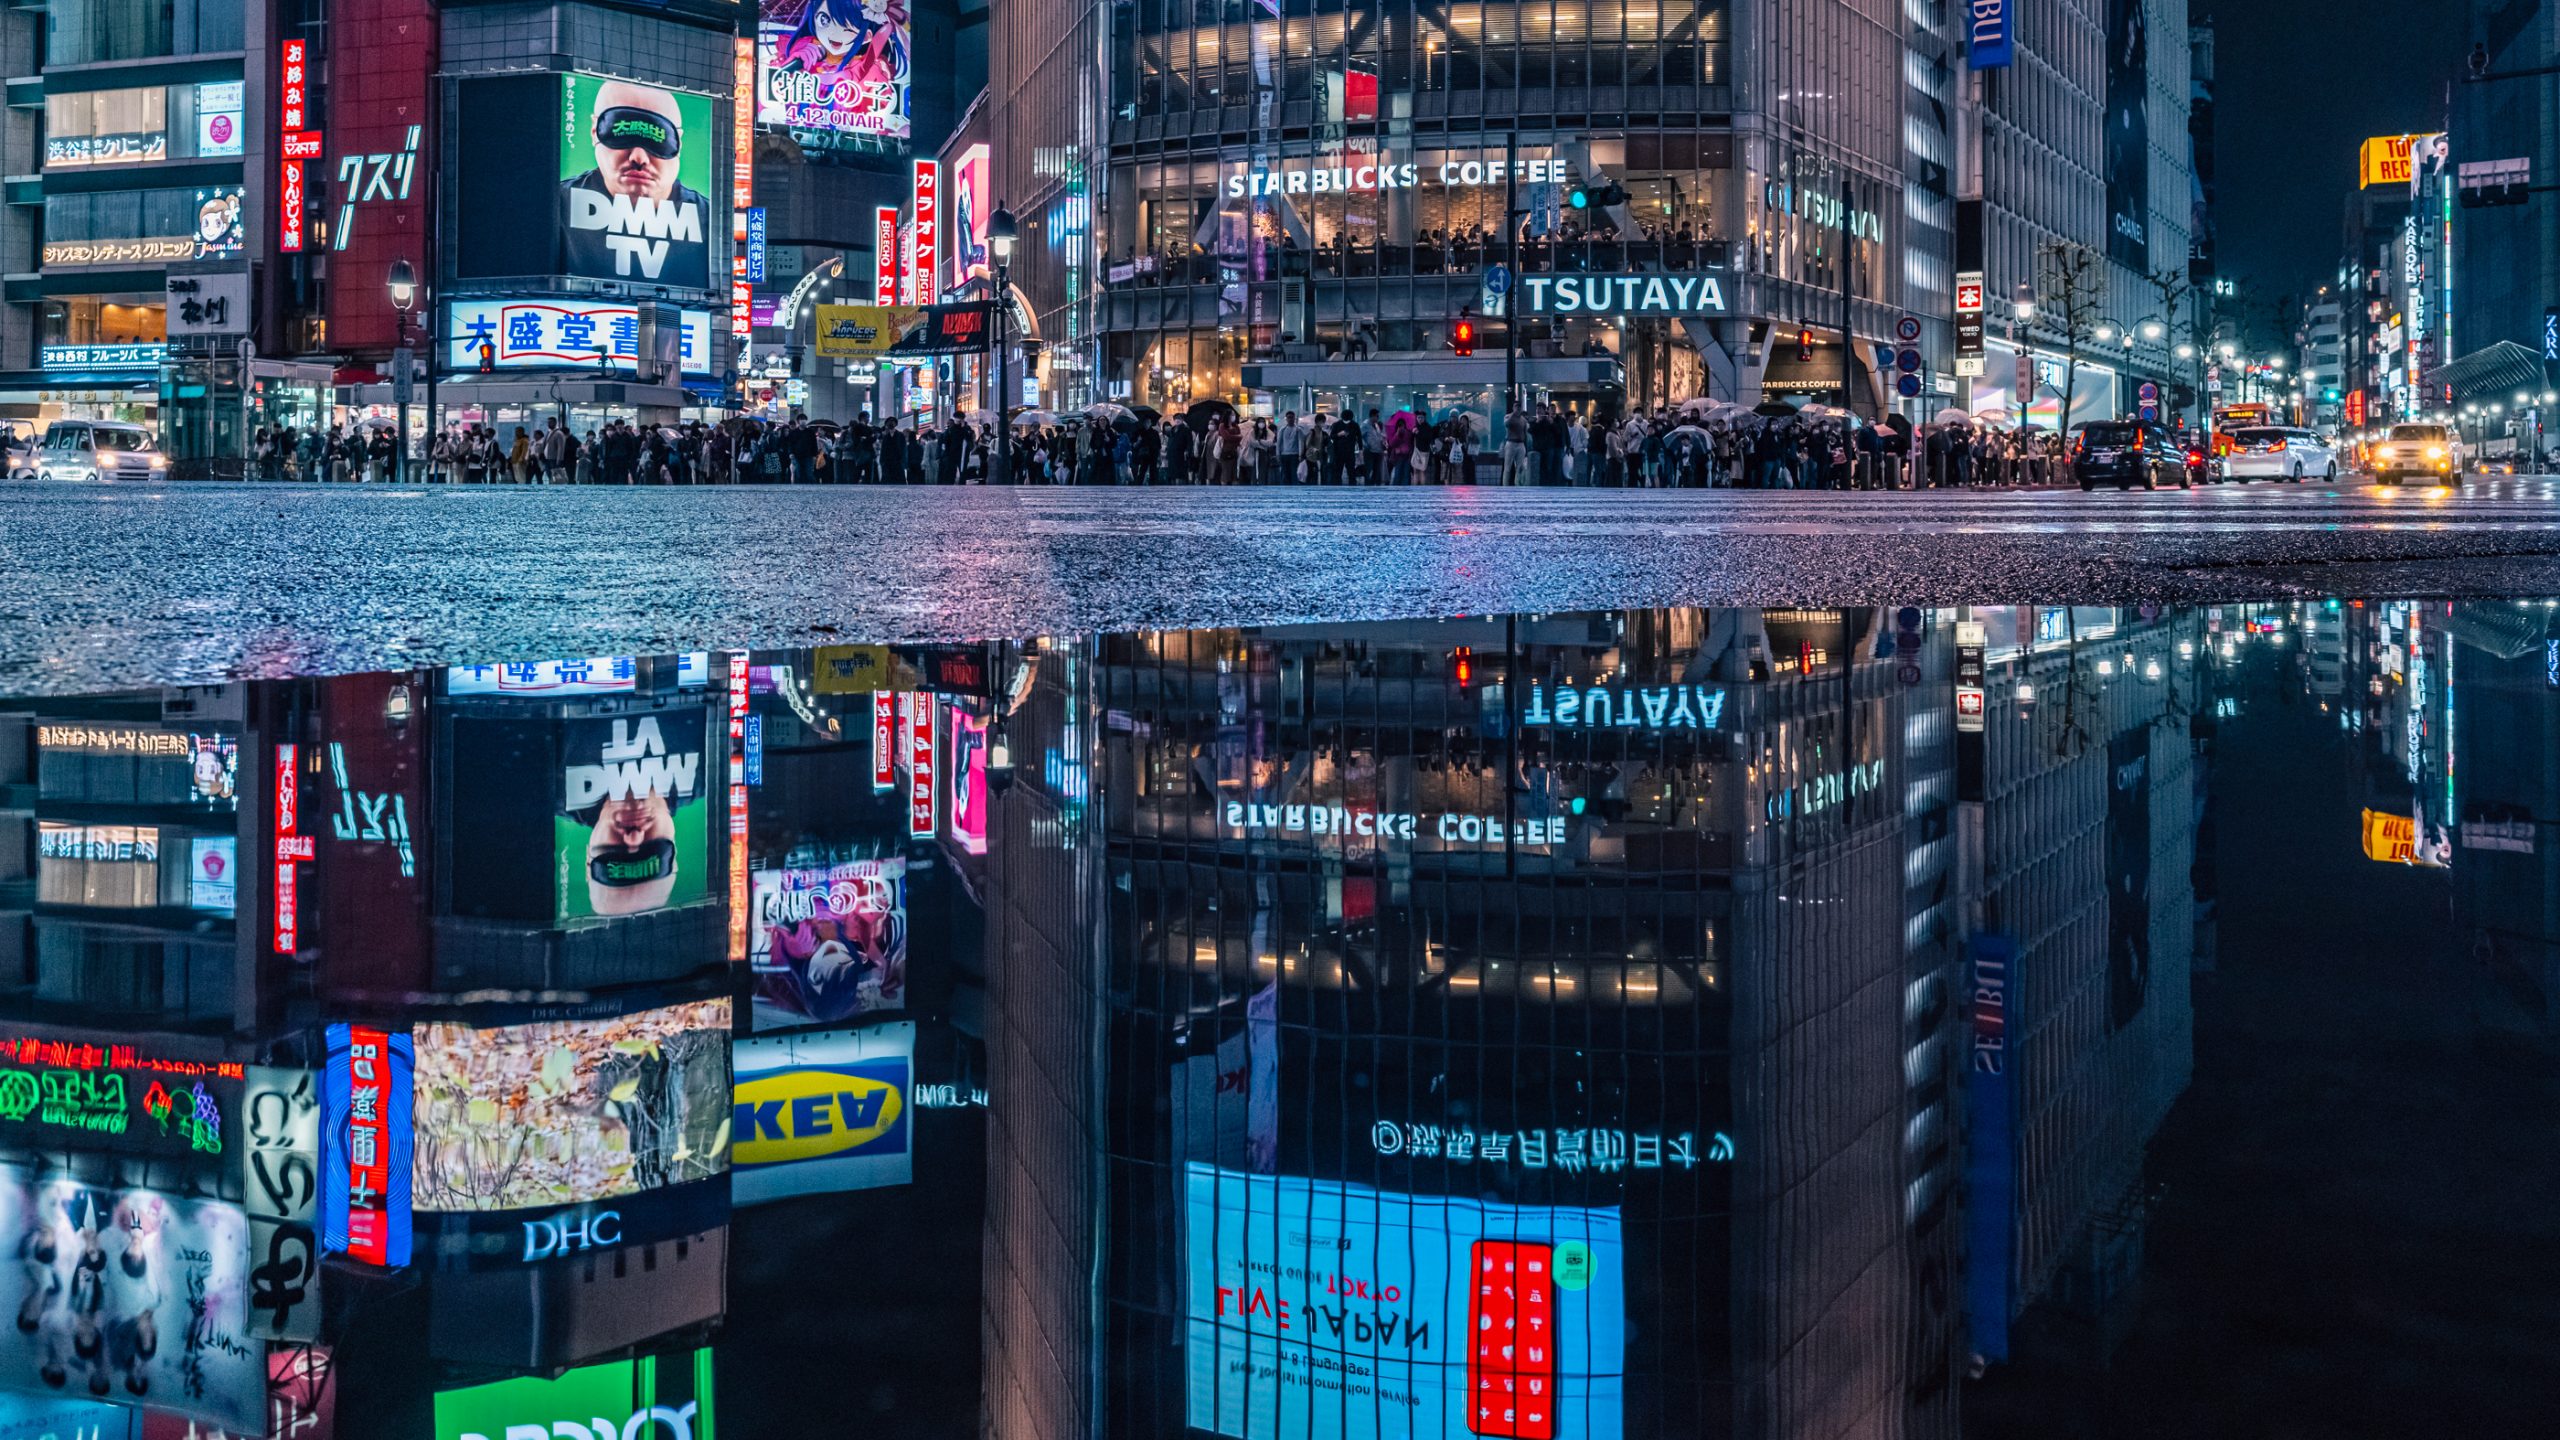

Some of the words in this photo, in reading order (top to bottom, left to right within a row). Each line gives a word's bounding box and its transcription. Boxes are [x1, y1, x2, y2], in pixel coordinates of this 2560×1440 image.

[286, 45, 302, 127] お好み焼
[335, 125, 422, 251] クスリ
[1228, 162, 1419, 198] STARBUCKS
[1439, 159, 1567, 185] COFFEE
[284, 164, 300, 248] もんじゃ焼
[570, 187, 703, 244] DMM
[917, 173, 934, 258] カラオケ
[751, 211, 764, 279] 大盛堂商事ビル
[880, 220, 891, 242] BIG
[2116, 211, 2145, 246] CHANEL
[605, 235, 670, 279] TV
[880, 242, 891, 268] ECHO
[1525, 276, 1726, 312] TSUTAYA
[1960, 287, 1979, 306] 本
[2546, 314, 2558, 360] ZARA
[681, 361, 704, 369] AISEIDO
[1761, 380, 1807, 389] TARBUCKS
[1808, 379, 1842, 388] COFFEE
